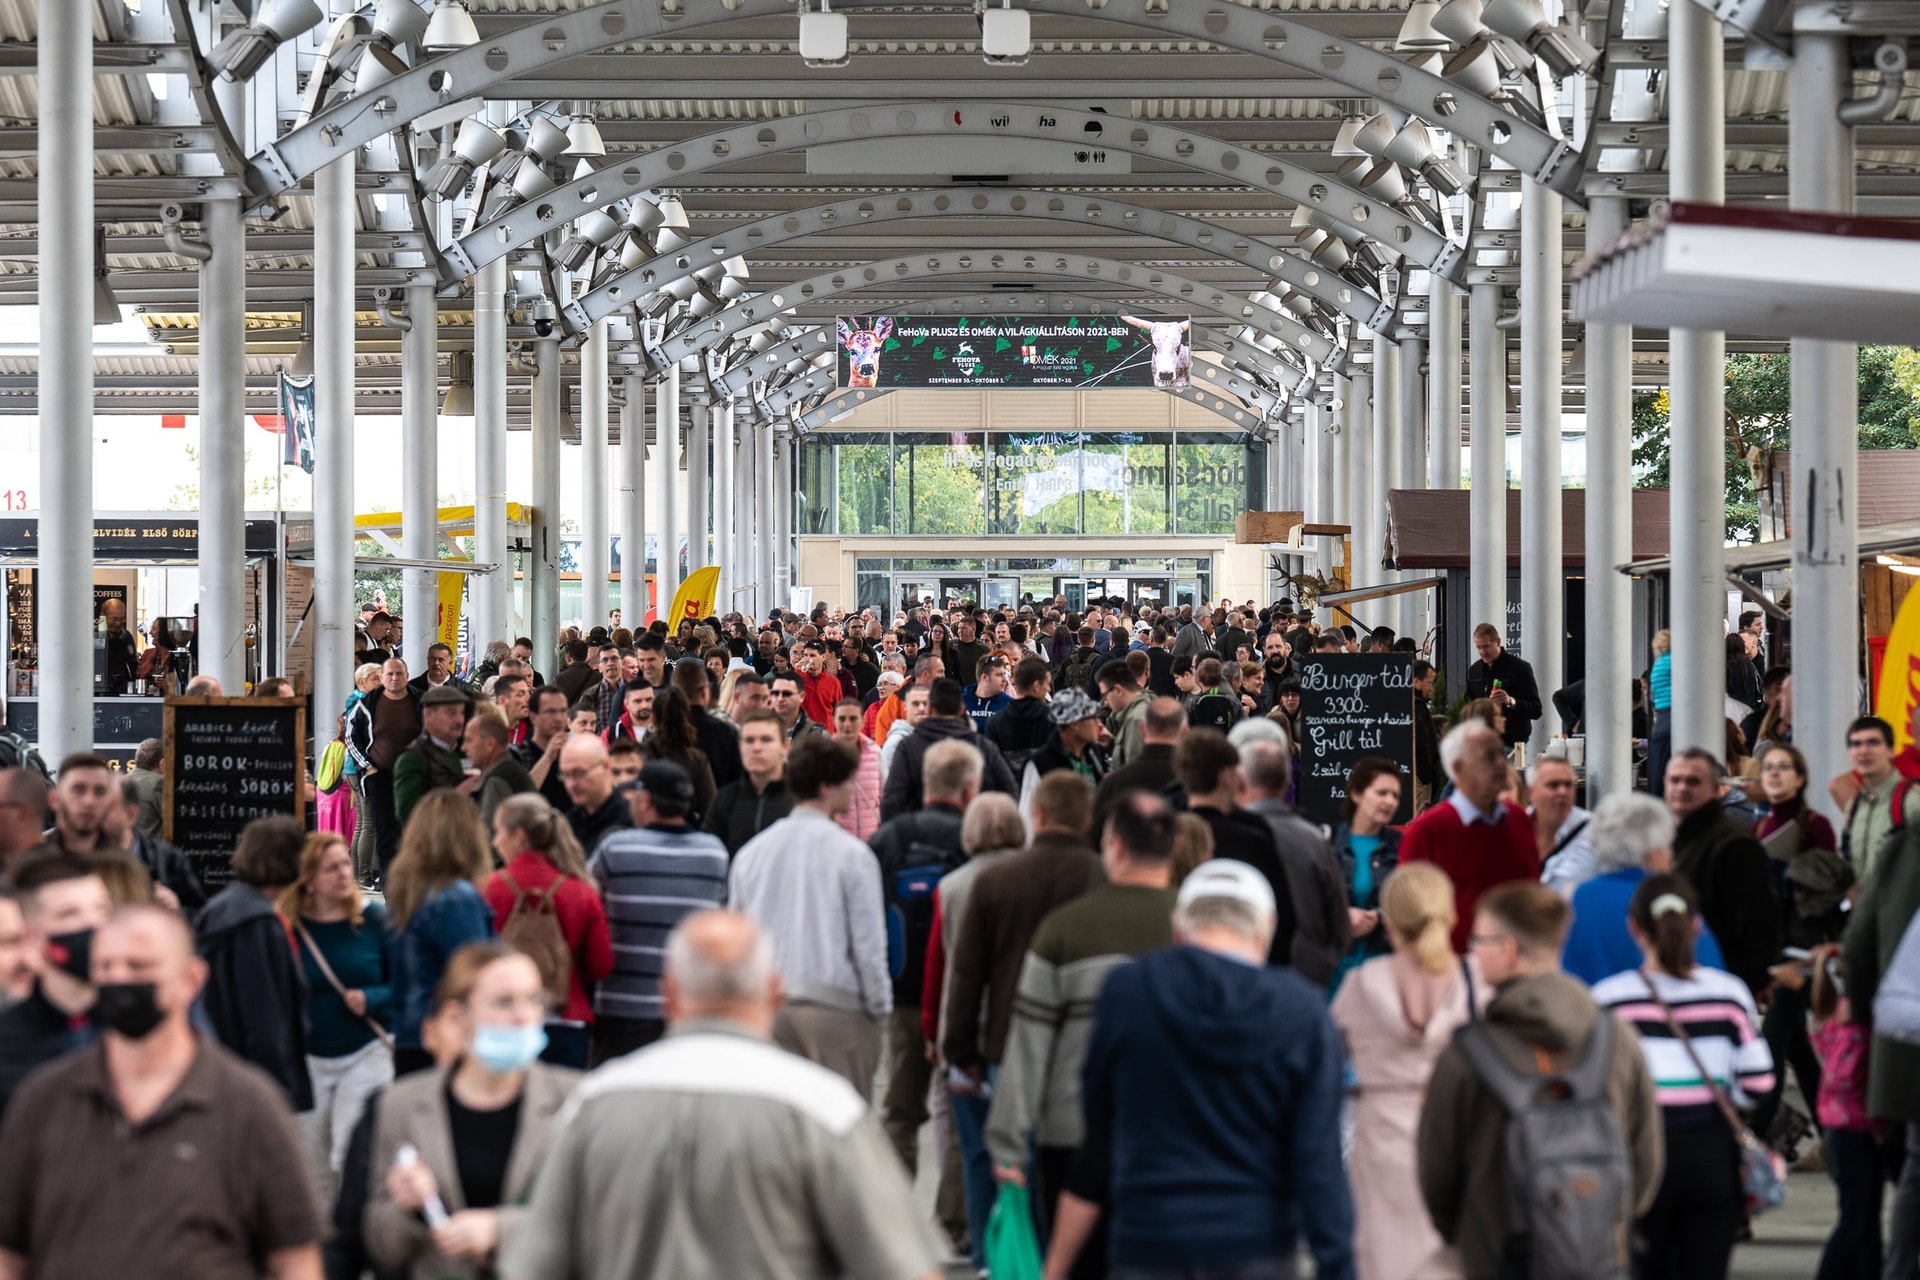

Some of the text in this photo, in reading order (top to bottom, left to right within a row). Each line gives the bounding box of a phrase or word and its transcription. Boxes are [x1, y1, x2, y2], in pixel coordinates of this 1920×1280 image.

[898, 325, 1128, 336] FeHoVa PLUSZ ÉS OMÉK A VILÁGKIÁLLÍTÁSON 2021-BEN
[3, 489, 27, 511] 13
[24, 529, 31, 537] A
[93, 527, 137, 537] ELVIDÉK
[142, 527, 168, 537] ELSŐ
[444, 603, 455, 640] passion
[1301, 662, 1377, 698] Burger
[1310, 726, 1354, 757] Grill
[240, 777, 294, 795] SÖRÖK
